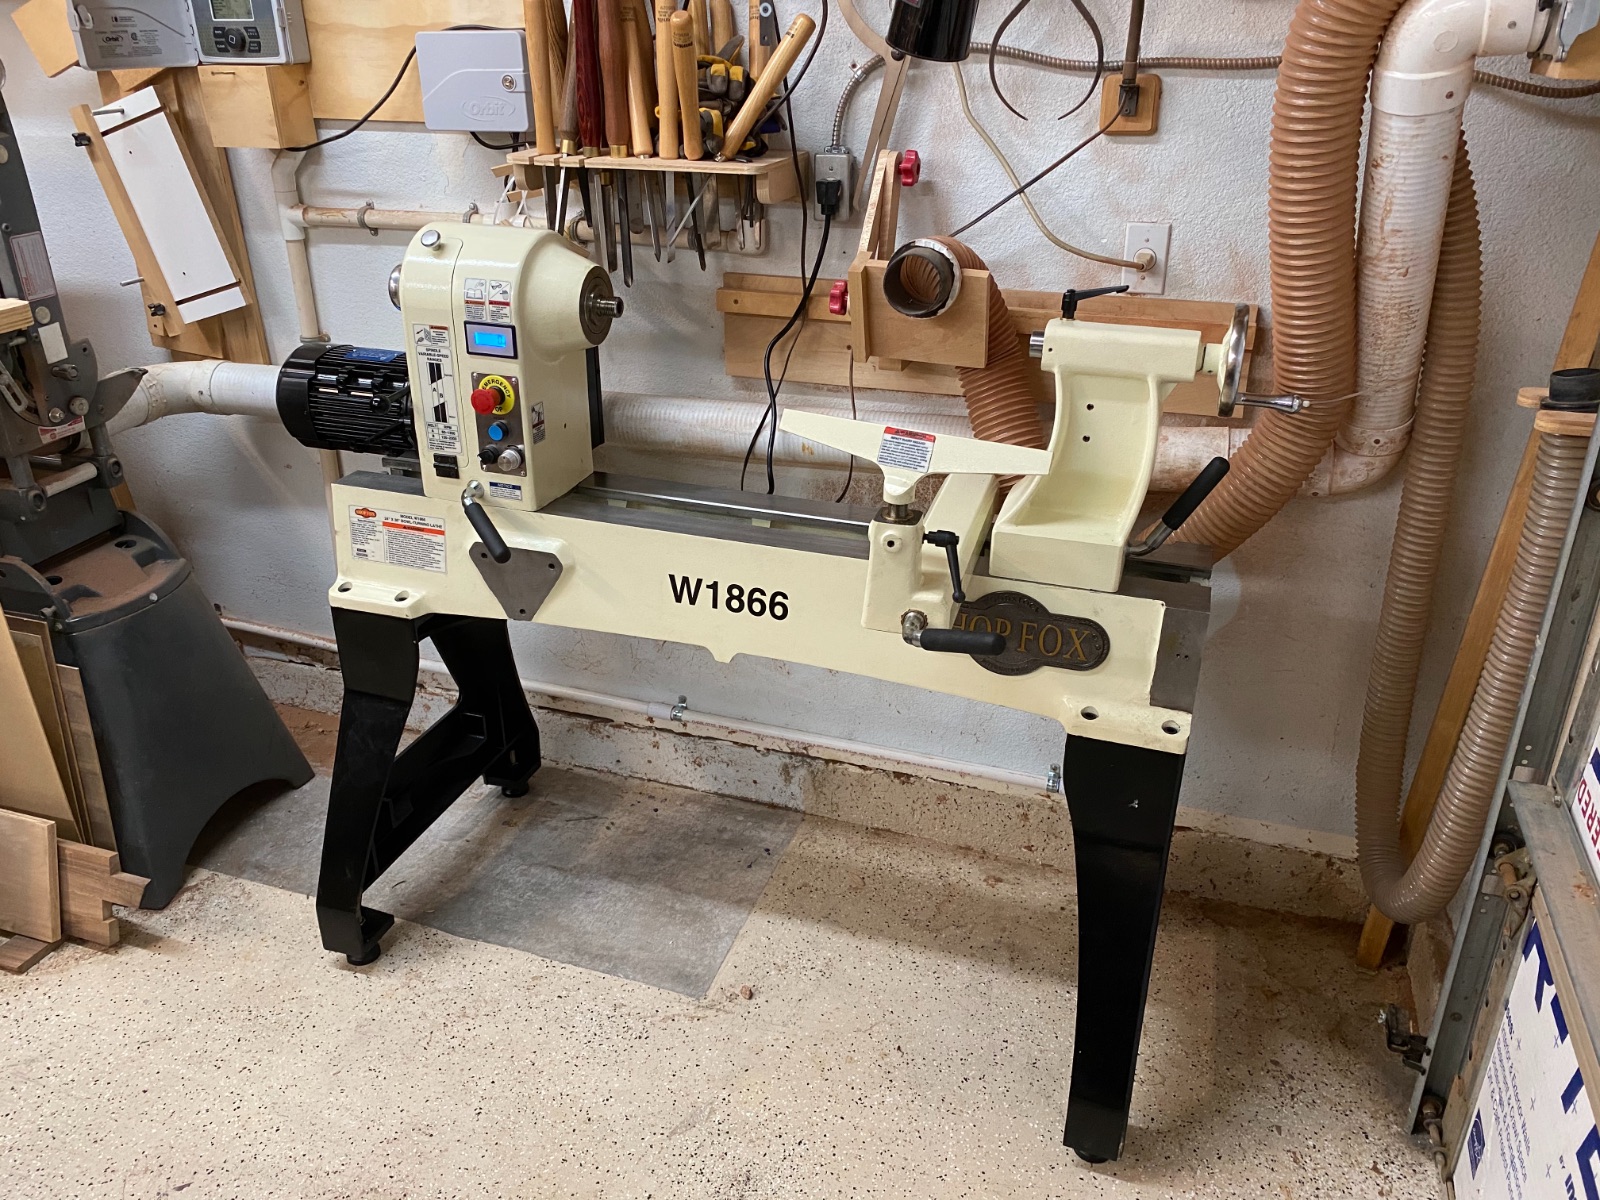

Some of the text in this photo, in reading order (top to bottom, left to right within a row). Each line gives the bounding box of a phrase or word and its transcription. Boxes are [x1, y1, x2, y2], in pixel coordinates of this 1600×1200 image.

[470, 101, 505, 116] Orbit
[482, 379, 511, 399] EMERGENCY
[668, 573, 789, 621] W1866
[1017, 621, 1091, 661] FOX
[1512, 1072, 1523, 1119] Exterior
[1521, 1117, 1531, 1157] Walls
[1509, 1105, 1519, 1142] Crawl
[1516, 1139, 1527, 1184] Space
[1559, 1154, 1566, 1170] BY
